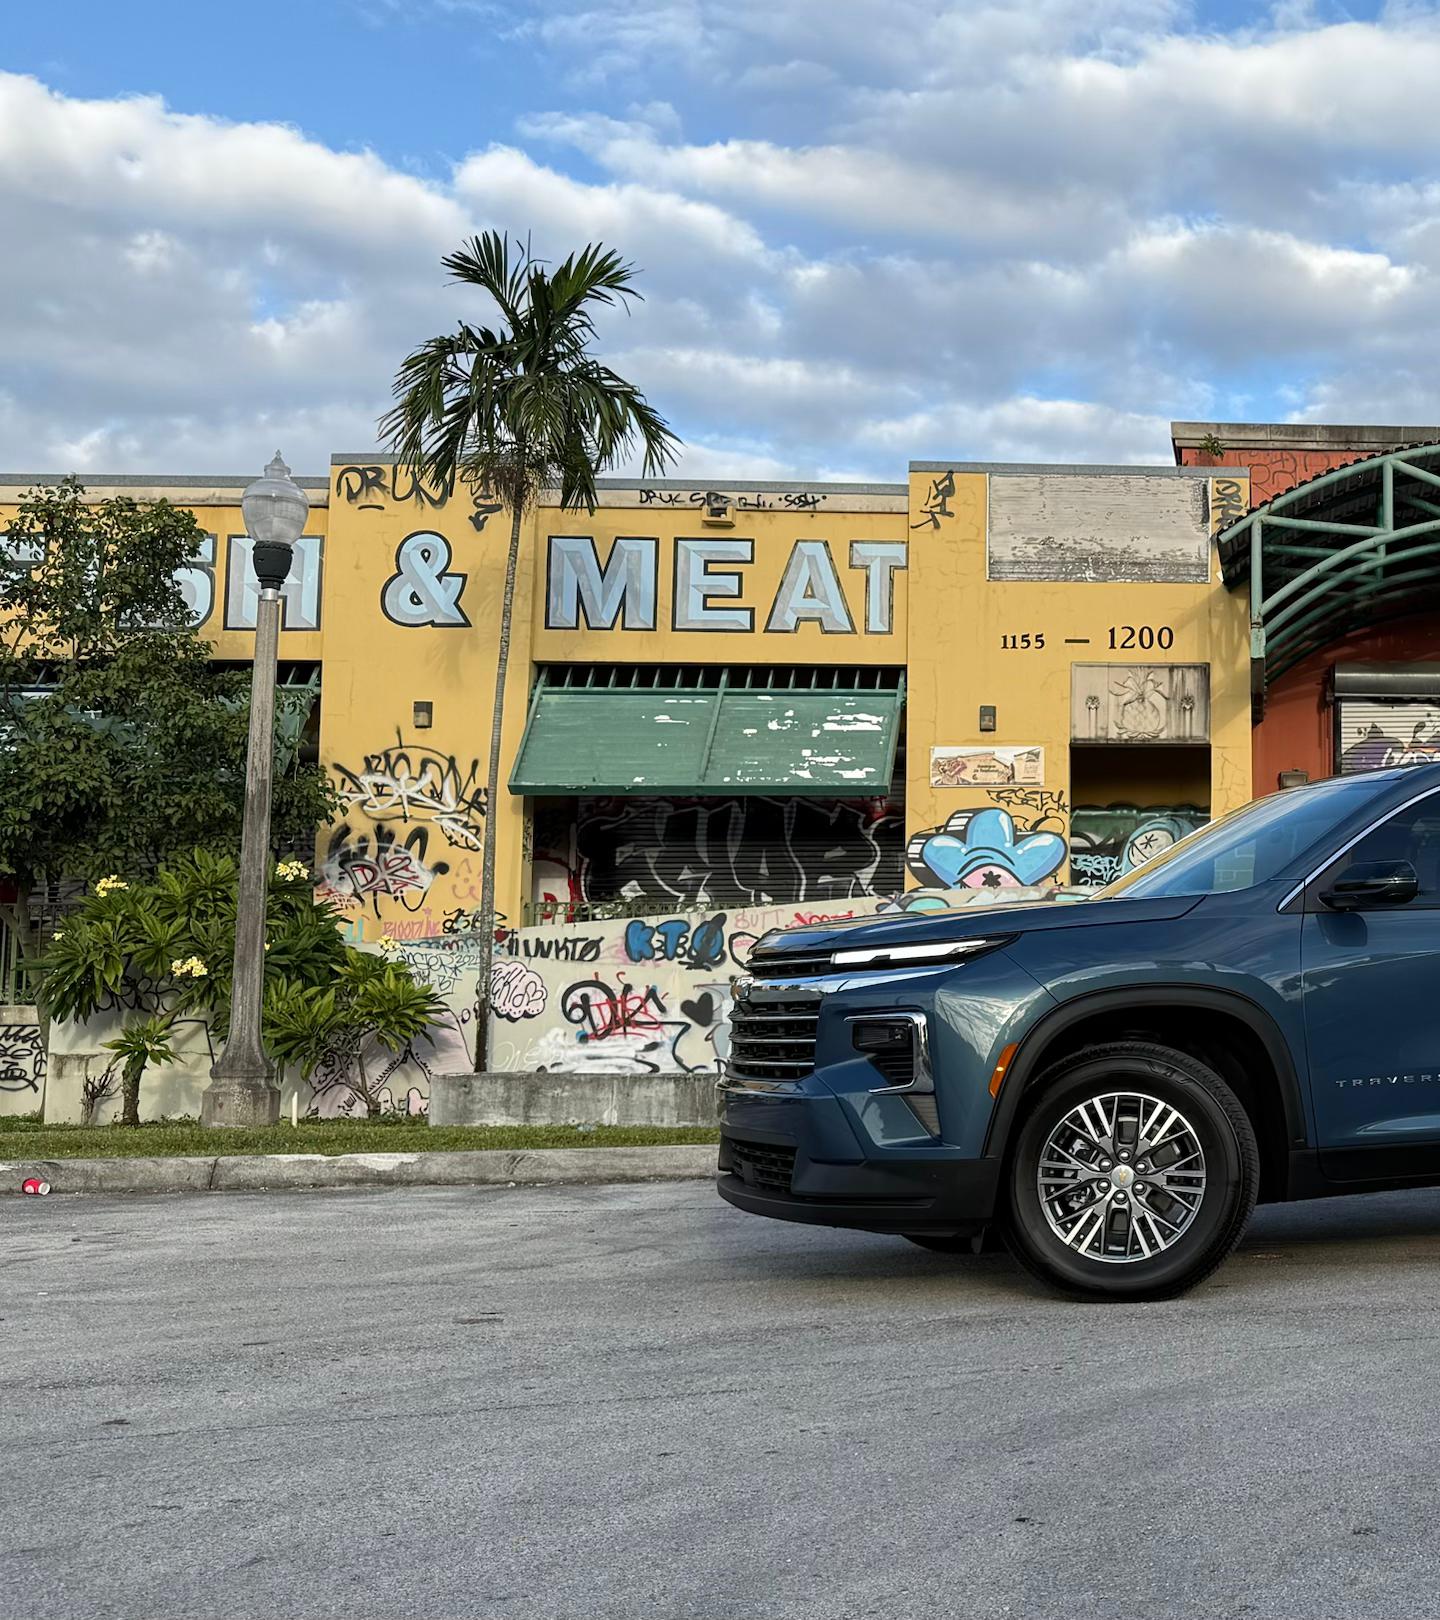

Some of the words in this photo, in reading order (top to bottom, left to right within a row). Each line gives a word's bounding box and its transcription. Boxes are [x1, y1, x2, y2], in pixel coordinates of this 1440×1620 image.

[380, 530, 471, 628] &
[545, 535, 908, 635] MEAT
[1001, 633, 1045, 650] 1155
[1108, 626, 1174, 650] 1200
